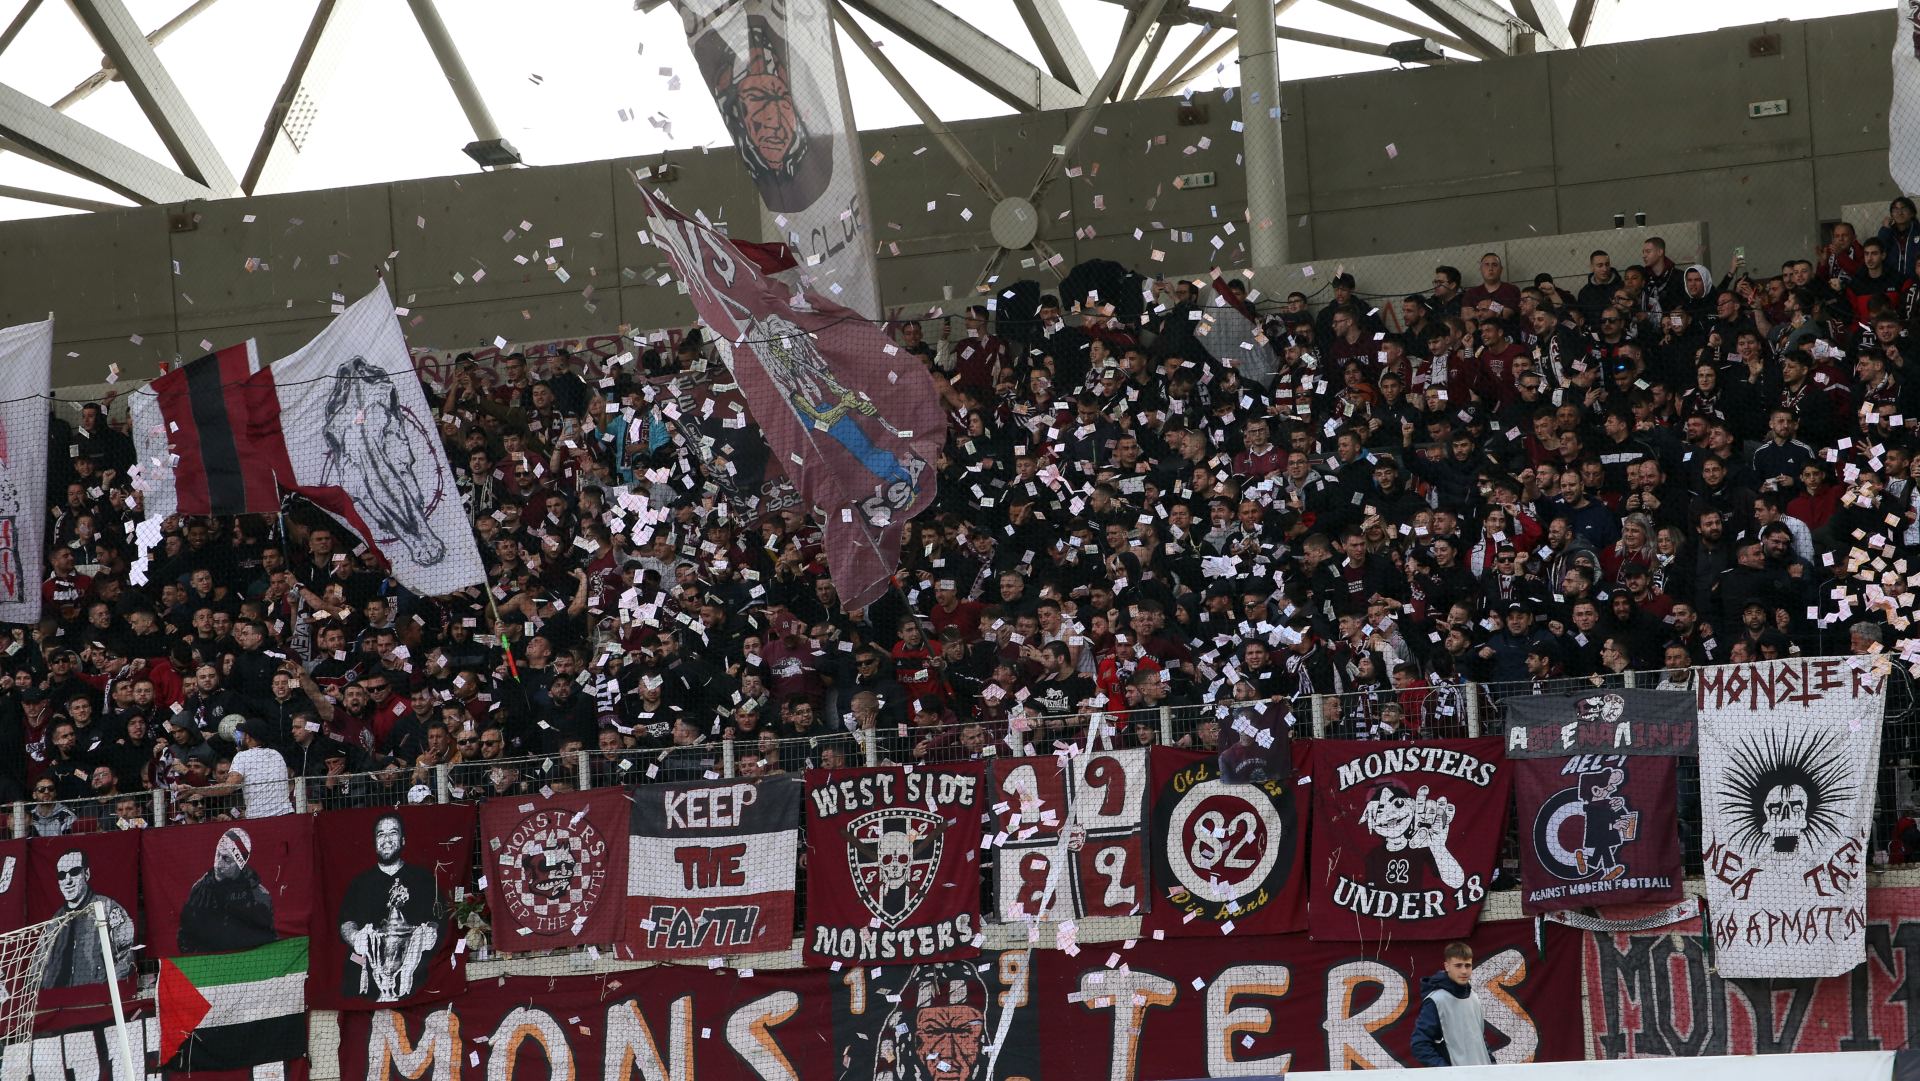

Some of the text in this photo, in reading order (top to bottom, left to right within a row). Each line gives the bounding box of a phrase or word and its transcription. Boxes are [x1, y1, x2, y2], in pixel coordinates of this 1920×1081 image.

[1003, 756, 1126, 823] 1 9
[1173, 764, 1209, 793] Old
[1337, 747, 1496, 791] MONSTERS
[665, 783, 757, 829] KEEP
[812, 773, 976, 818] WEST SIDE
[503, 811, 606, 857] MONSTERS
[1191, 811, 1258, 869] 82
[674, 843, 747, 891] THE
[865, 869, 923, 884] 8 2
[1016, 846, 1136, 915] 8 2
[1385, 858, 1410, 884] 82
[1529, 876, 1671, 902] AGAINST MODERN FOOTBALL
[501, 869, 605, 929] KEEP THE FAITH
[1333, 874, 1484, 919] UNDER 18
[648, 905, 760, 949] FAITH
[813, 914, 973, 960] MONSTERS
